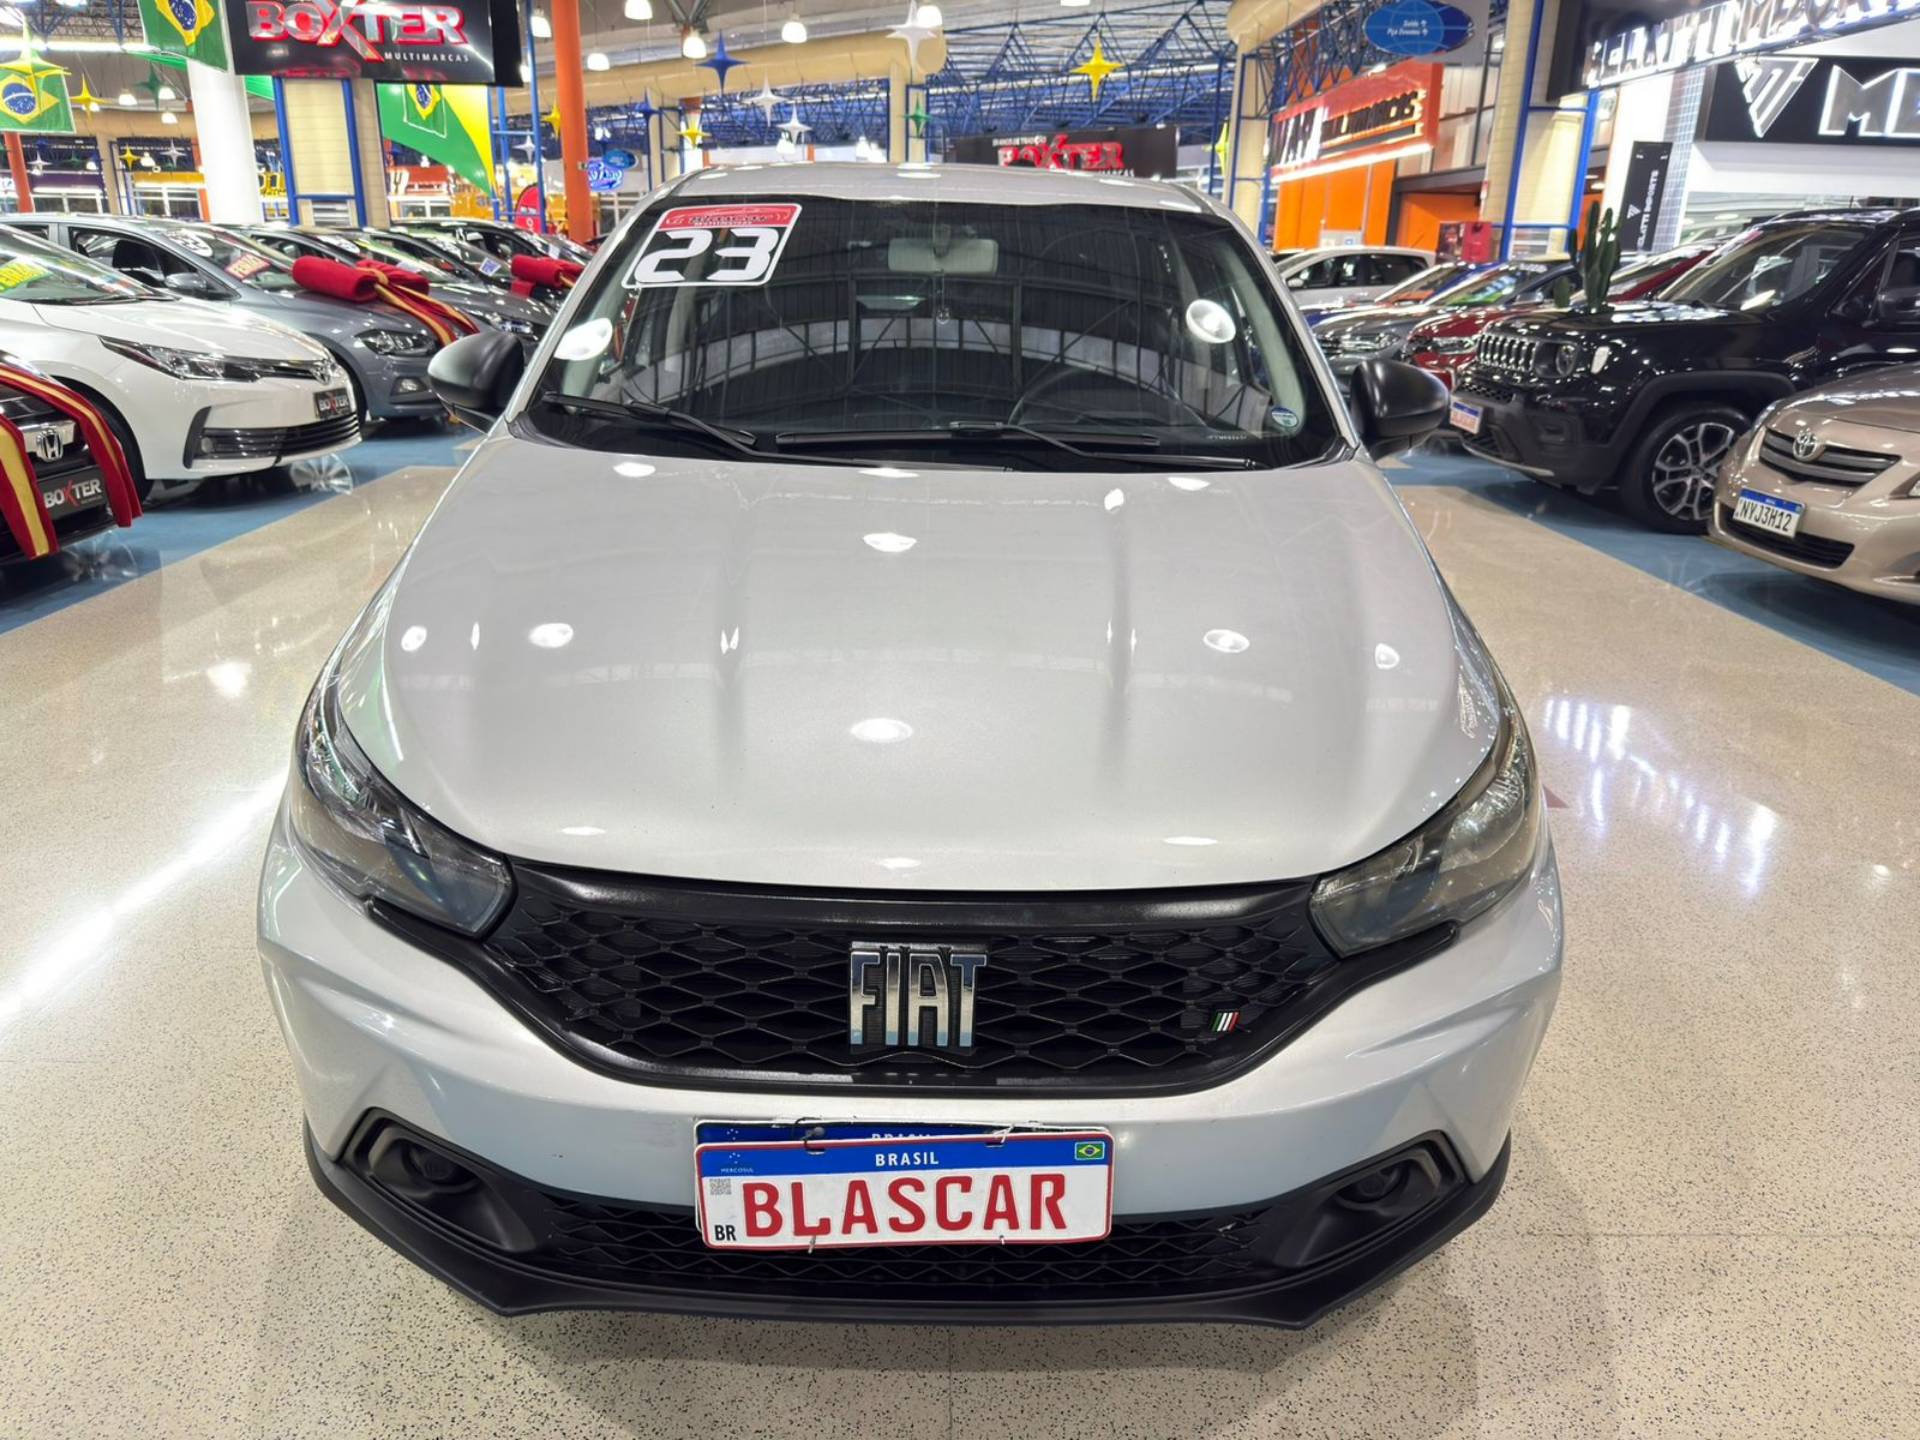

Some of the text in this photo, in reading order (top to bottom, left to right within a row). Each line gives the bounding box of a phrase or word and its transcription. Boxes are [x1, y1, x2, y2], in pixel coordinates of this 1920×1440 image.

[246, 0, 469, 62] BOXTER
[384, 51, 469, 63] MULTIMARCAS
[634, 228, 780, 283] 23
[44, 479, 102, 509] BOXTER
[1740, 500, 1793, 532] NYJ3H12
[850, 951, 987, 1047] FIAT
[875, 1151, 939, 1167] BRASIL
[742, 1173, 1067, 1238] BLASCAR
[713, 1224, 737, 1241] BR
